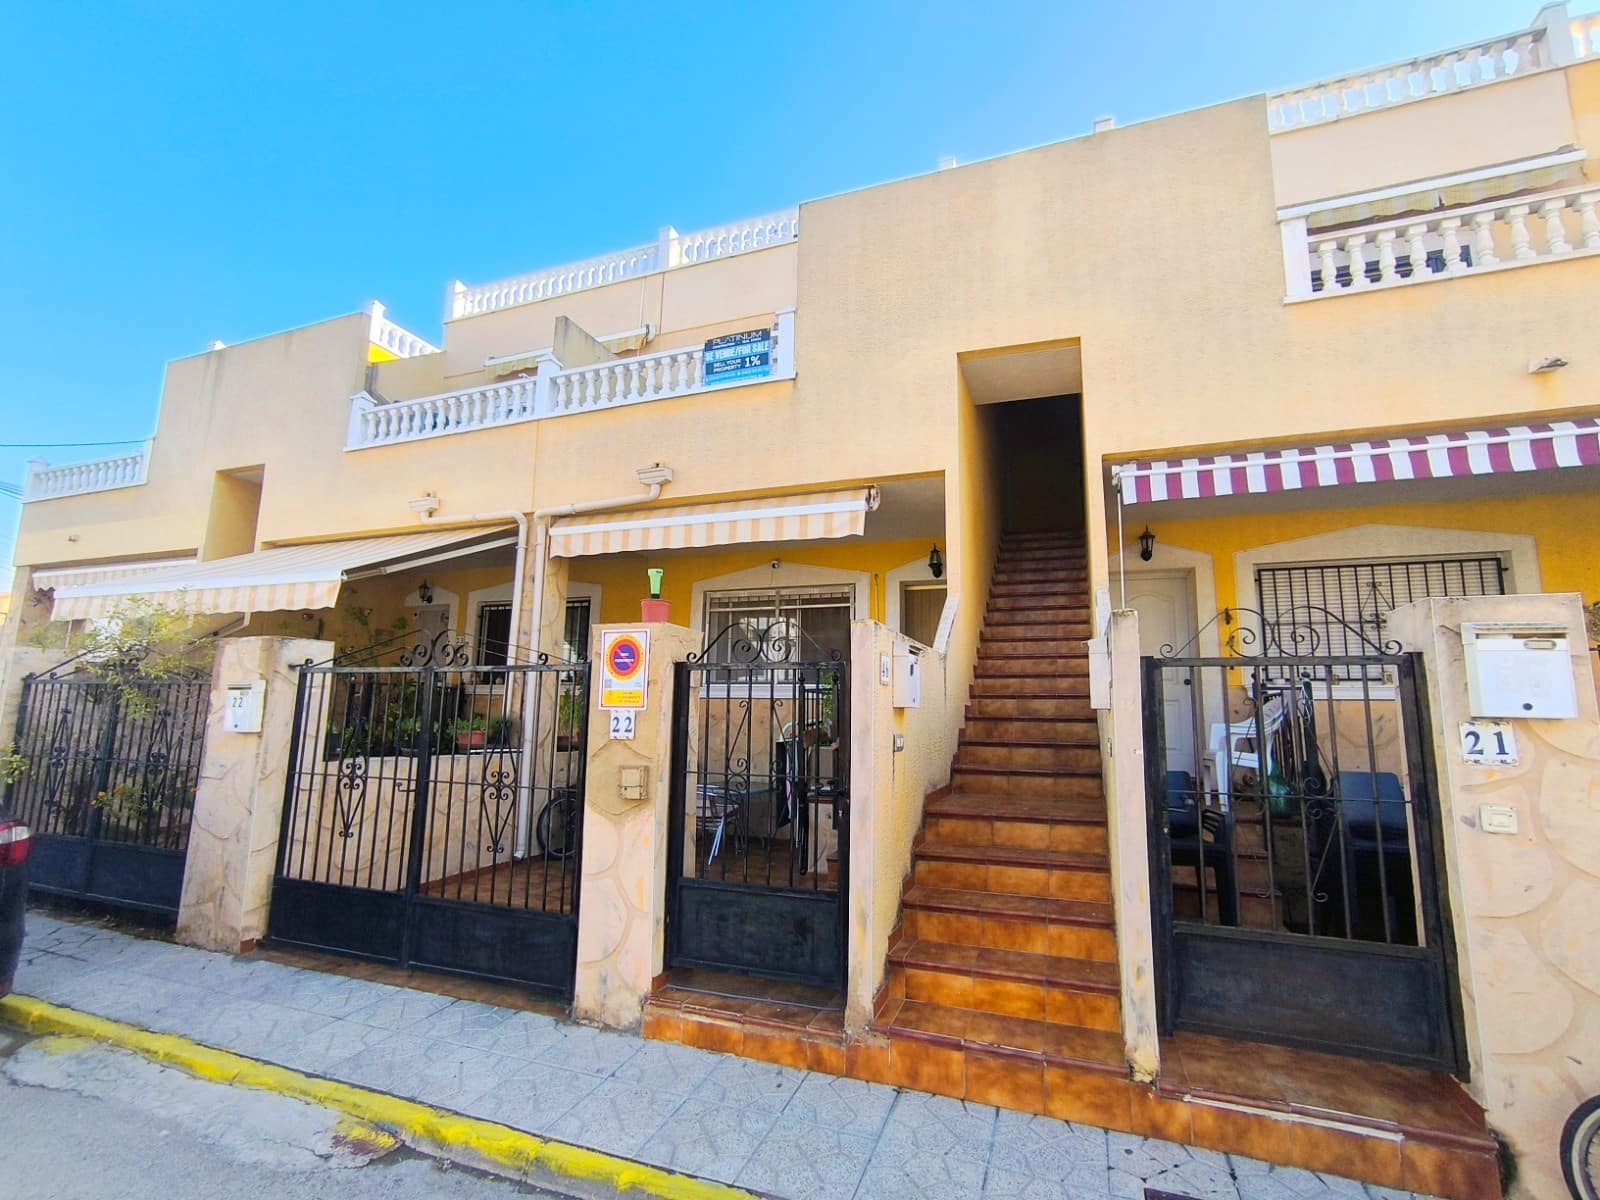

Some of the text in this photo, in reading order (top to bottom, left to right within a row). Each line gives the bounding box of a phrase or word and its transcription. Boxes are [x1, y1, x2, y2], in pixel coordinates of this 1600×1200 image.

[712, 330, 762, 346] PLATINUM
[744, 355, 761, 368] 1%
[231, 696, 243, 708] 22
[612, 716, 633, 733] 22
[1464, 730, 1510, 756] 21
